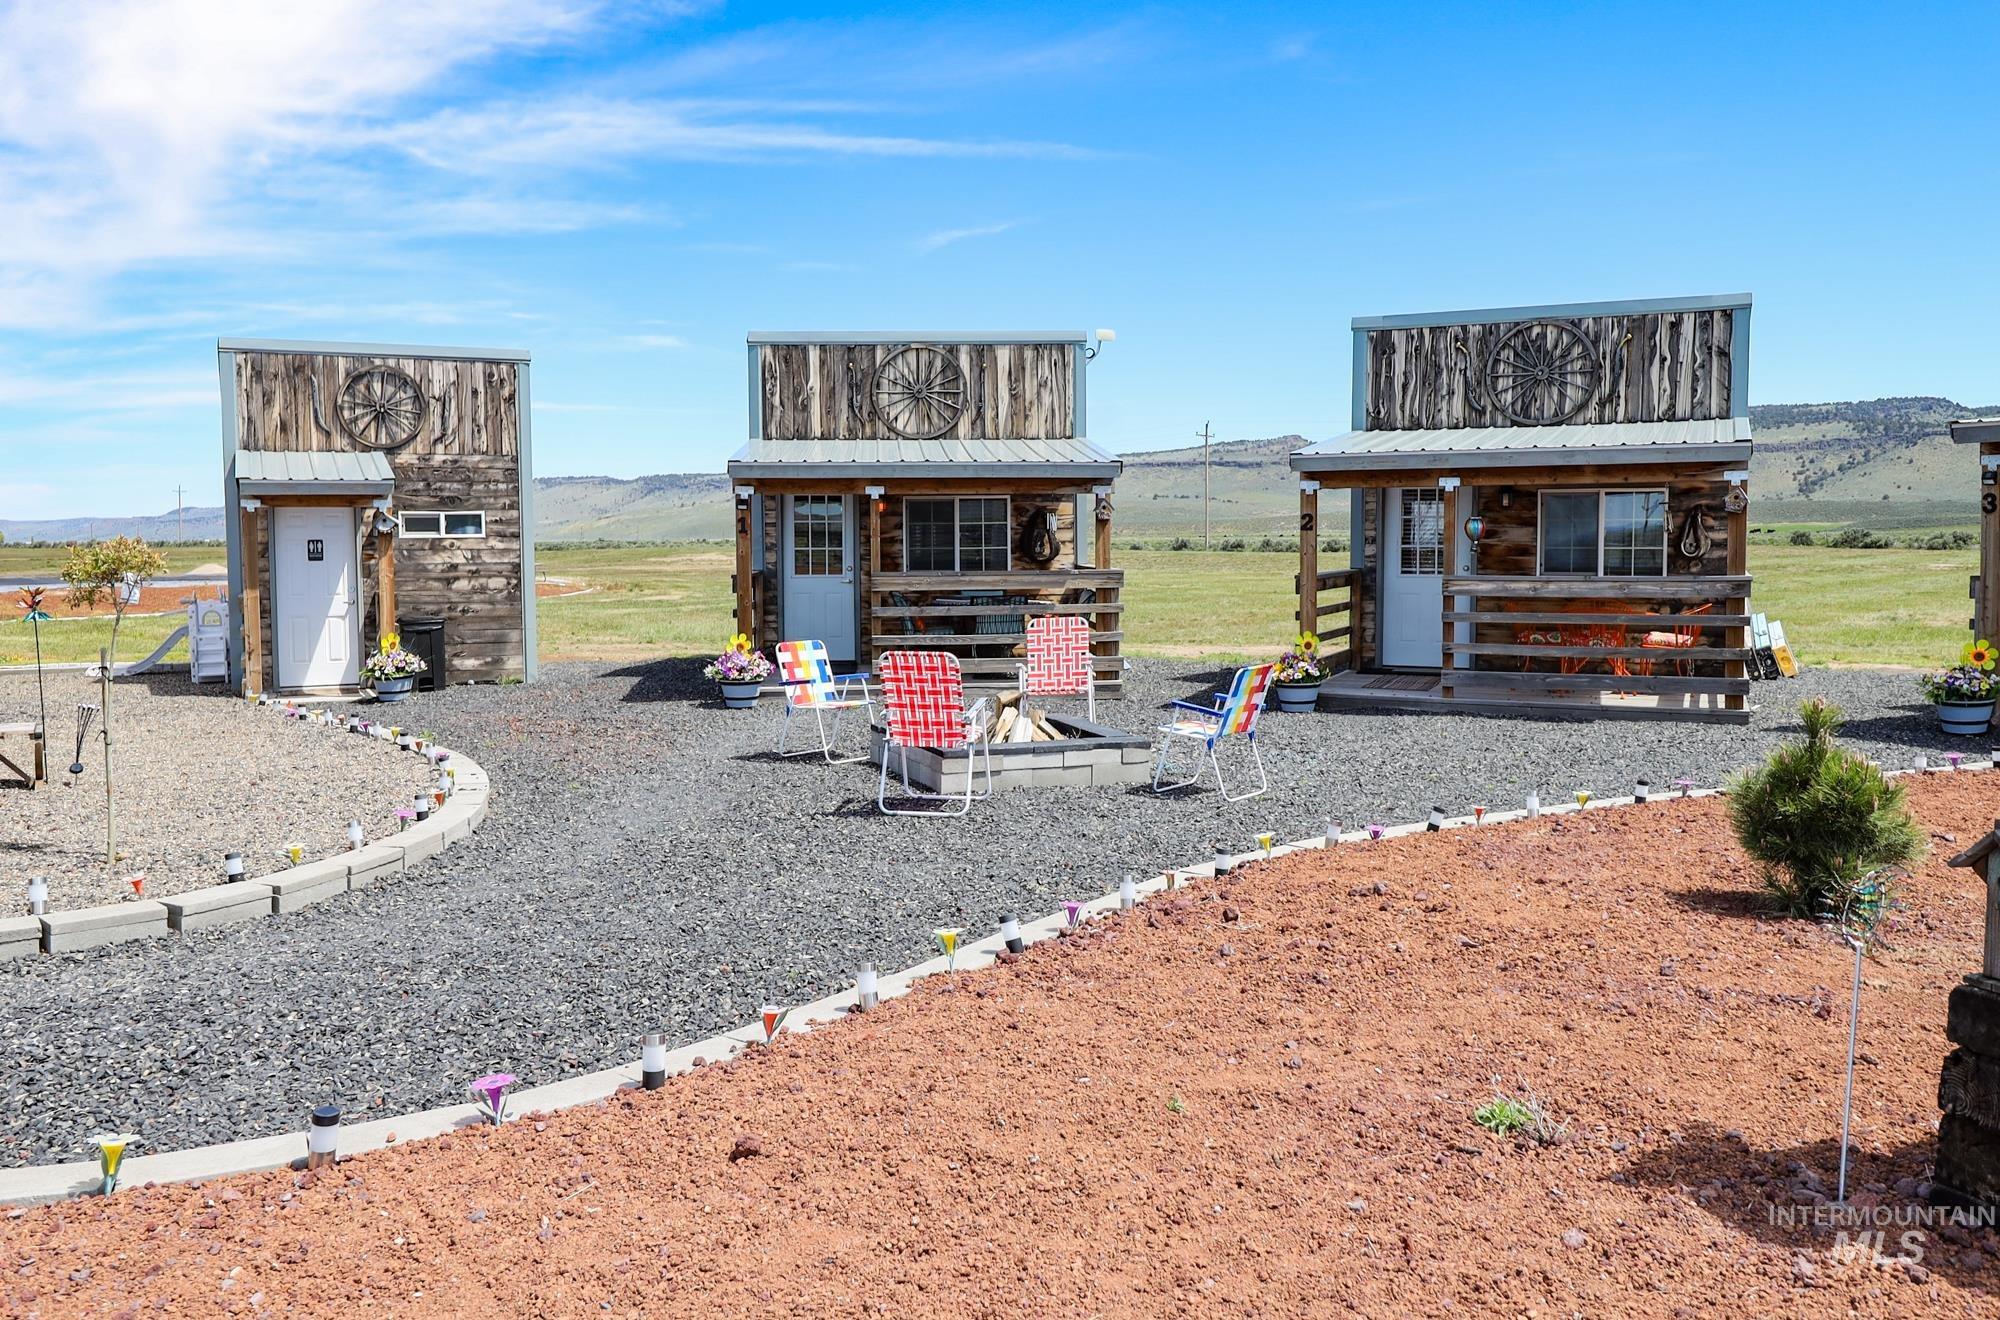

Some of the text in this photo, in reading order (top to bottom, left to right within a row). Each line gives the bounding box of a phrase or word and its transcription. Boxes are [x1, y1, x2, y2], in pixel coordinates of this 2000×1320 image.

[1982, 492, 1997, 514] 3
[738, 517, 748, 534] 1
[1301, 513, 1313, 531] 2
